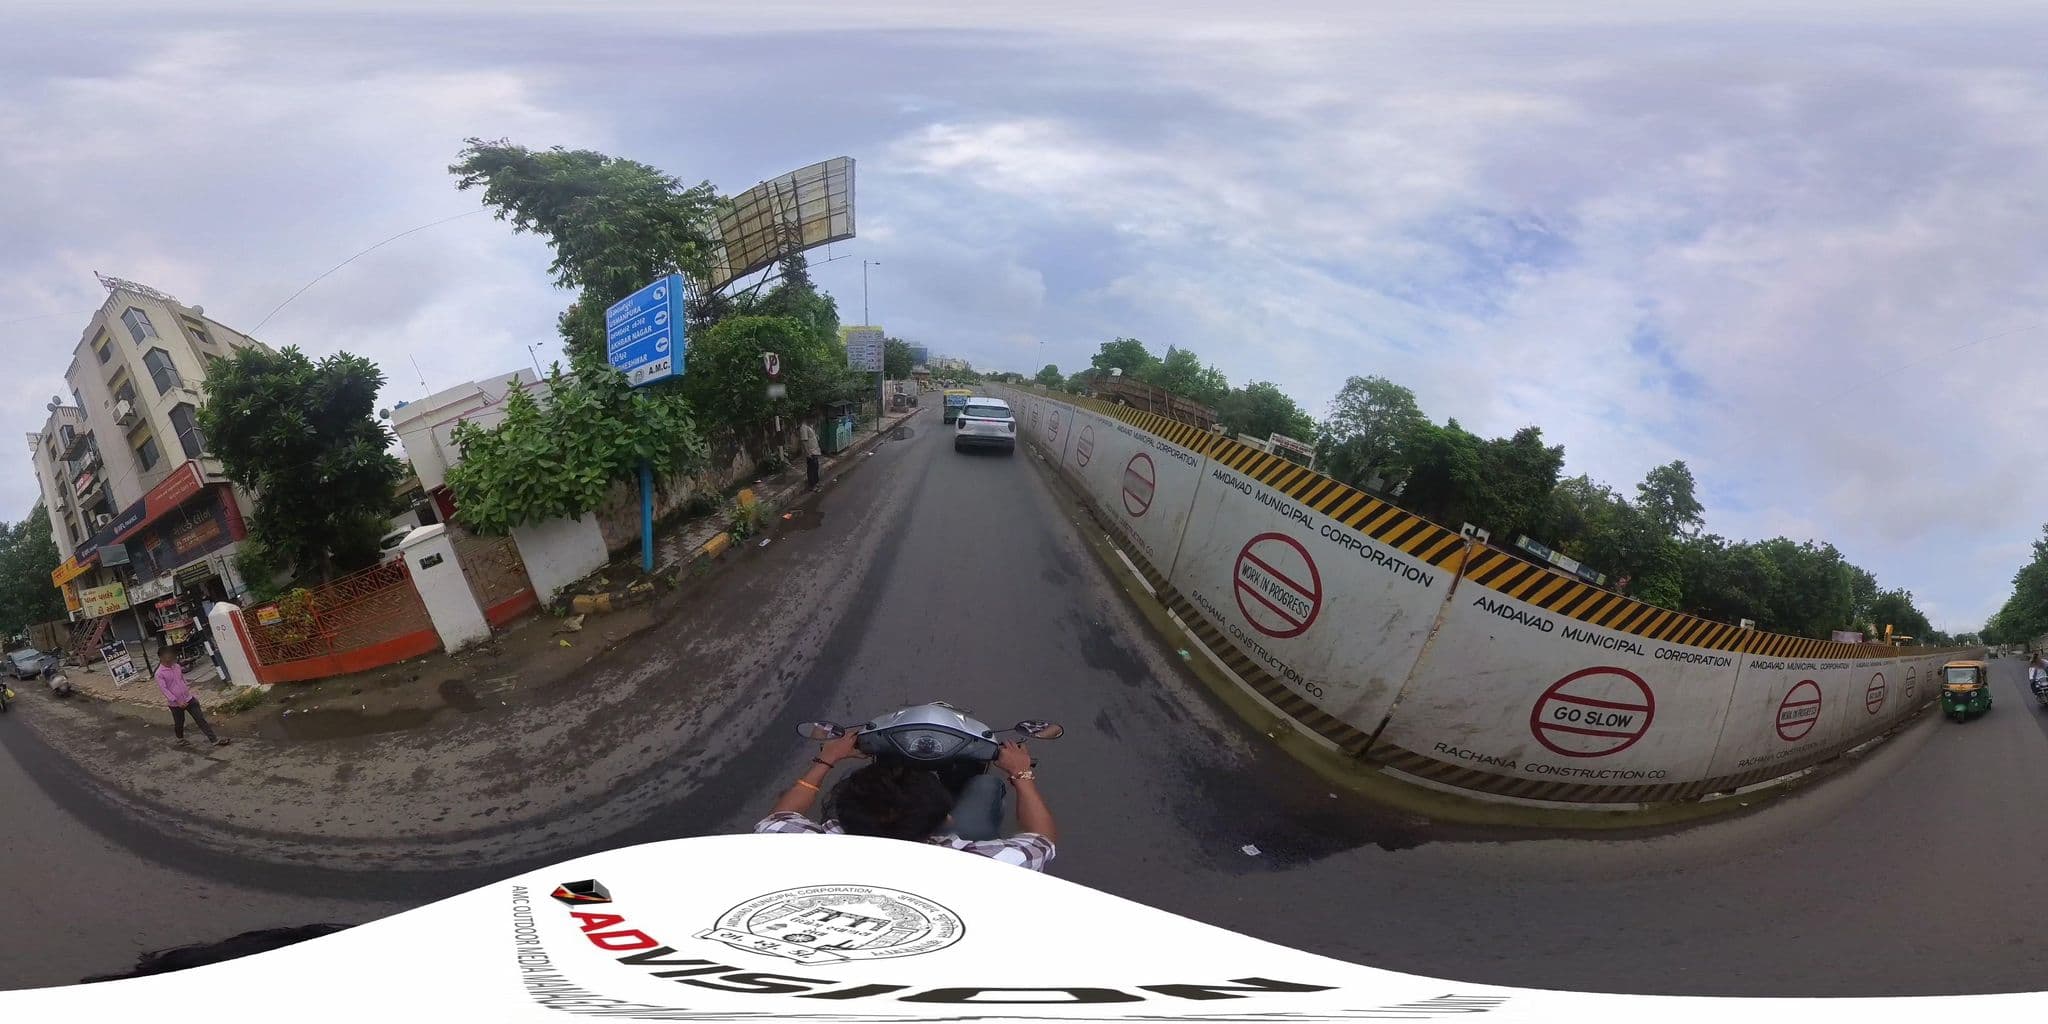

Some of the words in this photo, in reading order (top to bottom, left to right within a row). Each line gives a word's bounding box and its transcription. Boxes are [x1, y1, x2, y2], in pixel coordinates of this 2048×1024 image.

[632, 325, 652, 340] NAGAR
[648, 361, 671, 375] A.M.C.
[1156, 441, 1198, 468] CORPORATION
[1212, 468, 1253, 496] AMDAVAD
[1255, 489, 1314, 530] MUNICIPAL
[1320, 524, 1434, 588] CORPORATION
[1241, 562, 1260, 588] WORK
[1258, 576, 1270, 593] IN
[1269, 582, 1311, 619] PROGRESS
[1191, 590, 1226, 627] RACHANA
[1229, 624, 1304, 686] CONSTRUCTION
[1305, 681, 1323, 700] CO.
[1473, 596, 1554, 633] AMDAVAD
[1561, 625, 1646, 656] MUNICIPAL
[1654, 647, 1732, 668] CORPORATION
[1750, 660, 1785, 670] AMDAVAD
[1786, 663, 1817, 671] MUNICIPAL
[1553, 706, 1581, 723] GO
[1583, 712, 1633, 728] SLOW
[1433, 742, 1517, 770] RACHANA
[1524, 762, 1646, 780] CONSTRUCTION
